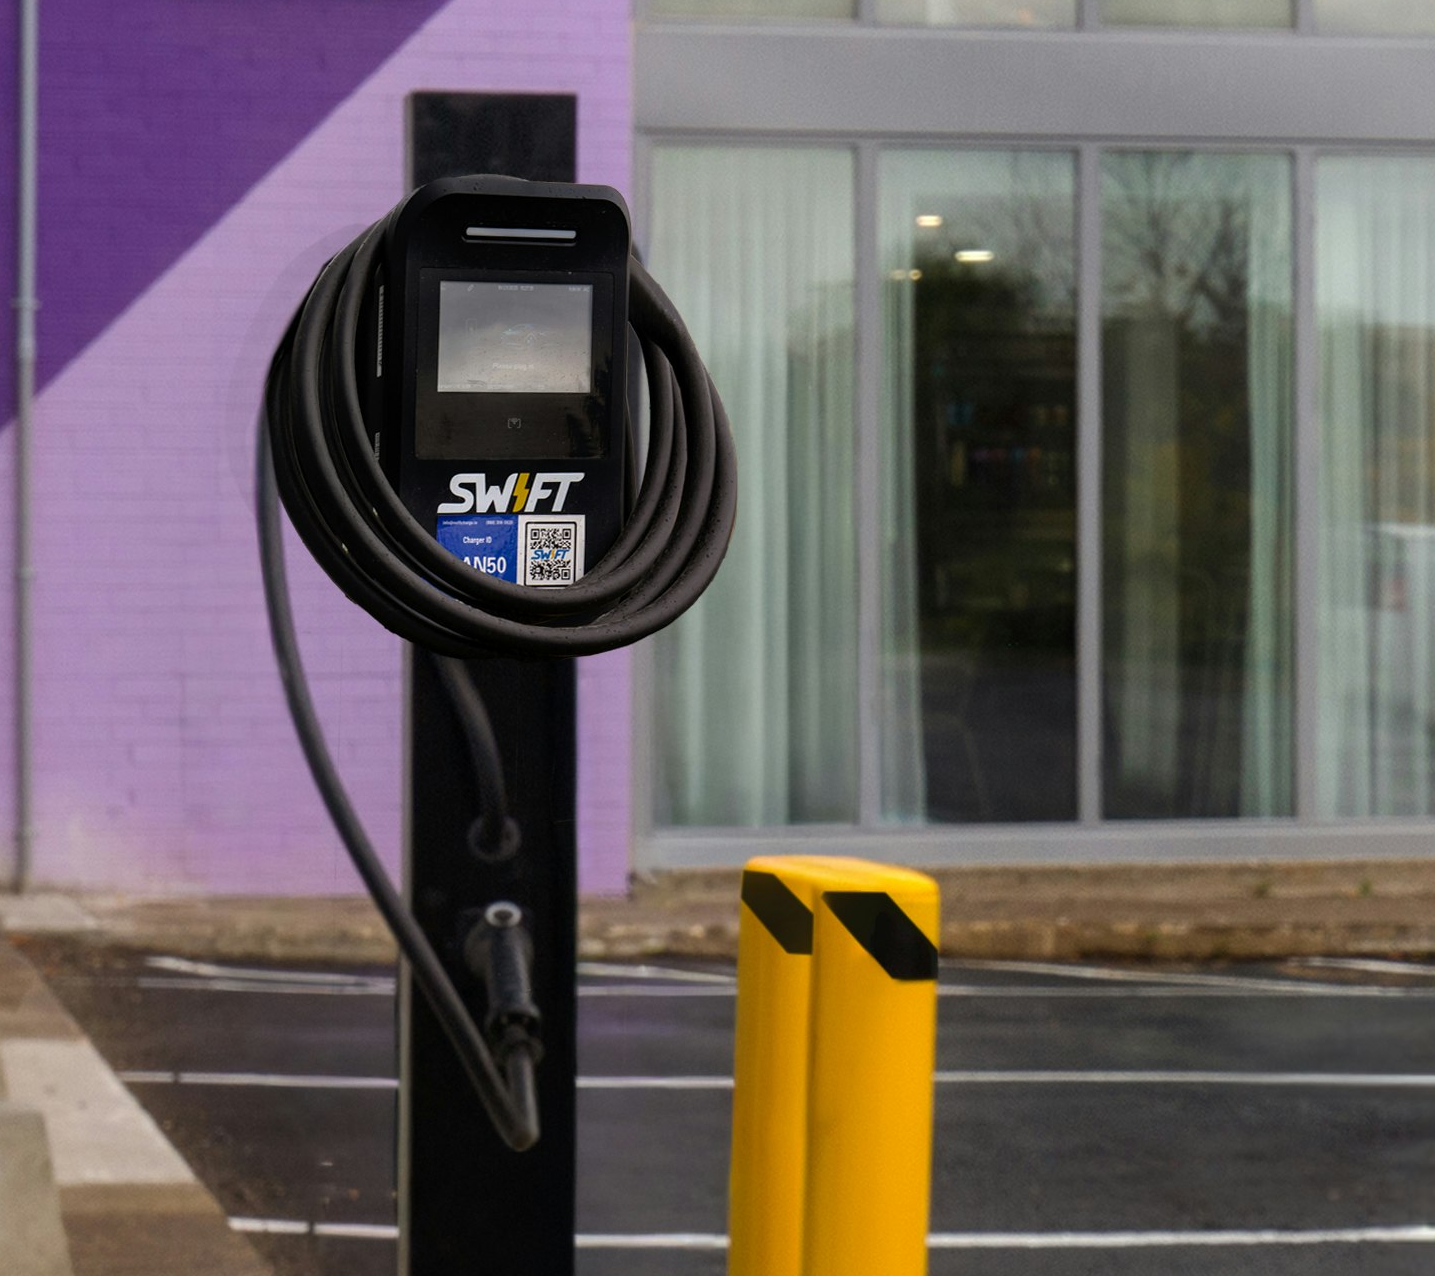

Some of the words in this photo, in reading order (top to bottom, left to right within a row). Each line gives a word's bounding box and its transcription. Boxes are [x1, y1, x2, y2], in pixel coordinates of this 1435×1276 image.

[437, 472, 585, 514] SWIFT
[462, 536, 485, 545] Charger
[530, 549, 571, 560] SWIFT
